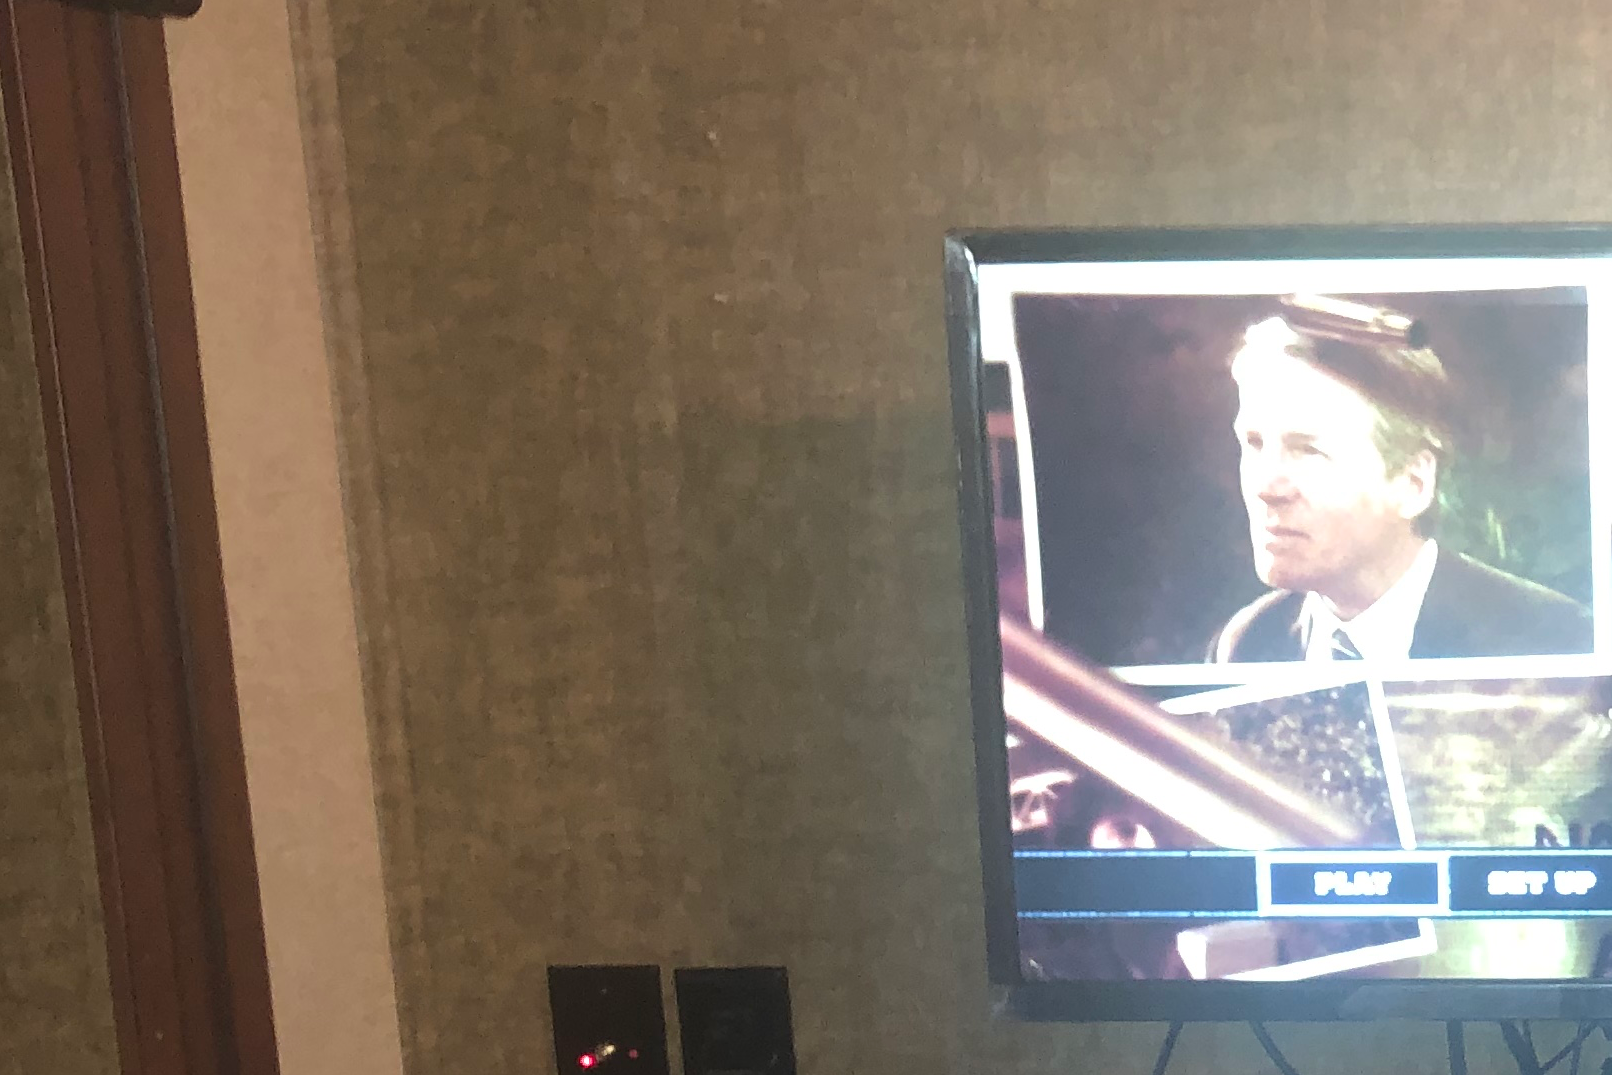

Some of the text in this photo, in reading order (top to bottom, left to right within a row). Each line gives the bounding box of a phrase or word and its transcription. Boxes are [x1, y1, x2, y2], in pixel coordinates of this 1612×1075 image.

[1314, 871, 1392, 896] PLAY
[1487, 870, 1598, 895] SET UP
